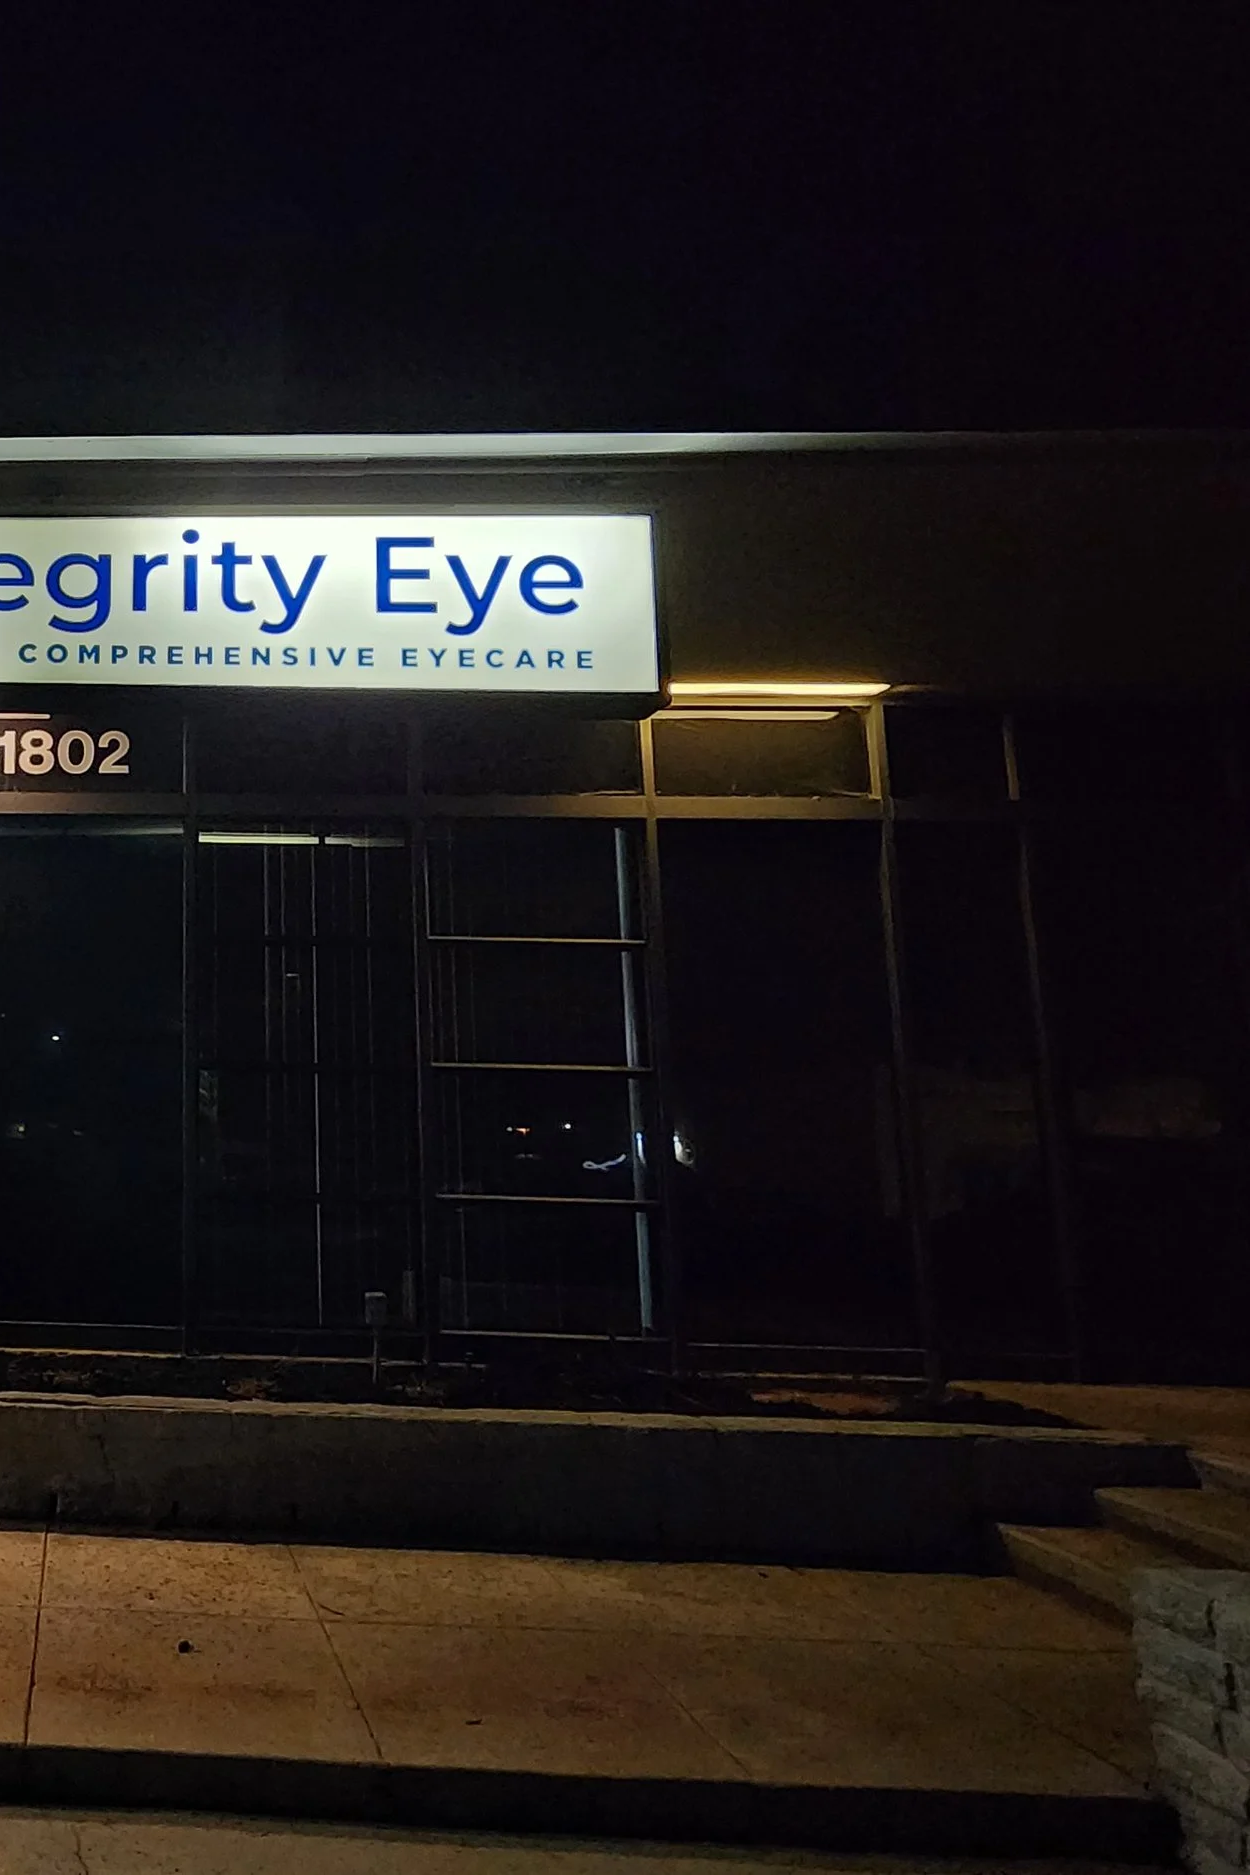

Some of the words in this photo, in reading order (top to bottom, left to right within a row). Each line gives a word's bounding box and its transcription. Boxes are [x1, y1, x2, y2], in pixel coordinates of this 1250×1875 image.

[374, 536, 585, 637] Eye
[17, 643, 376, 668] COMPREHENSIVE
[400, 647, 595, 670] EYECARE
